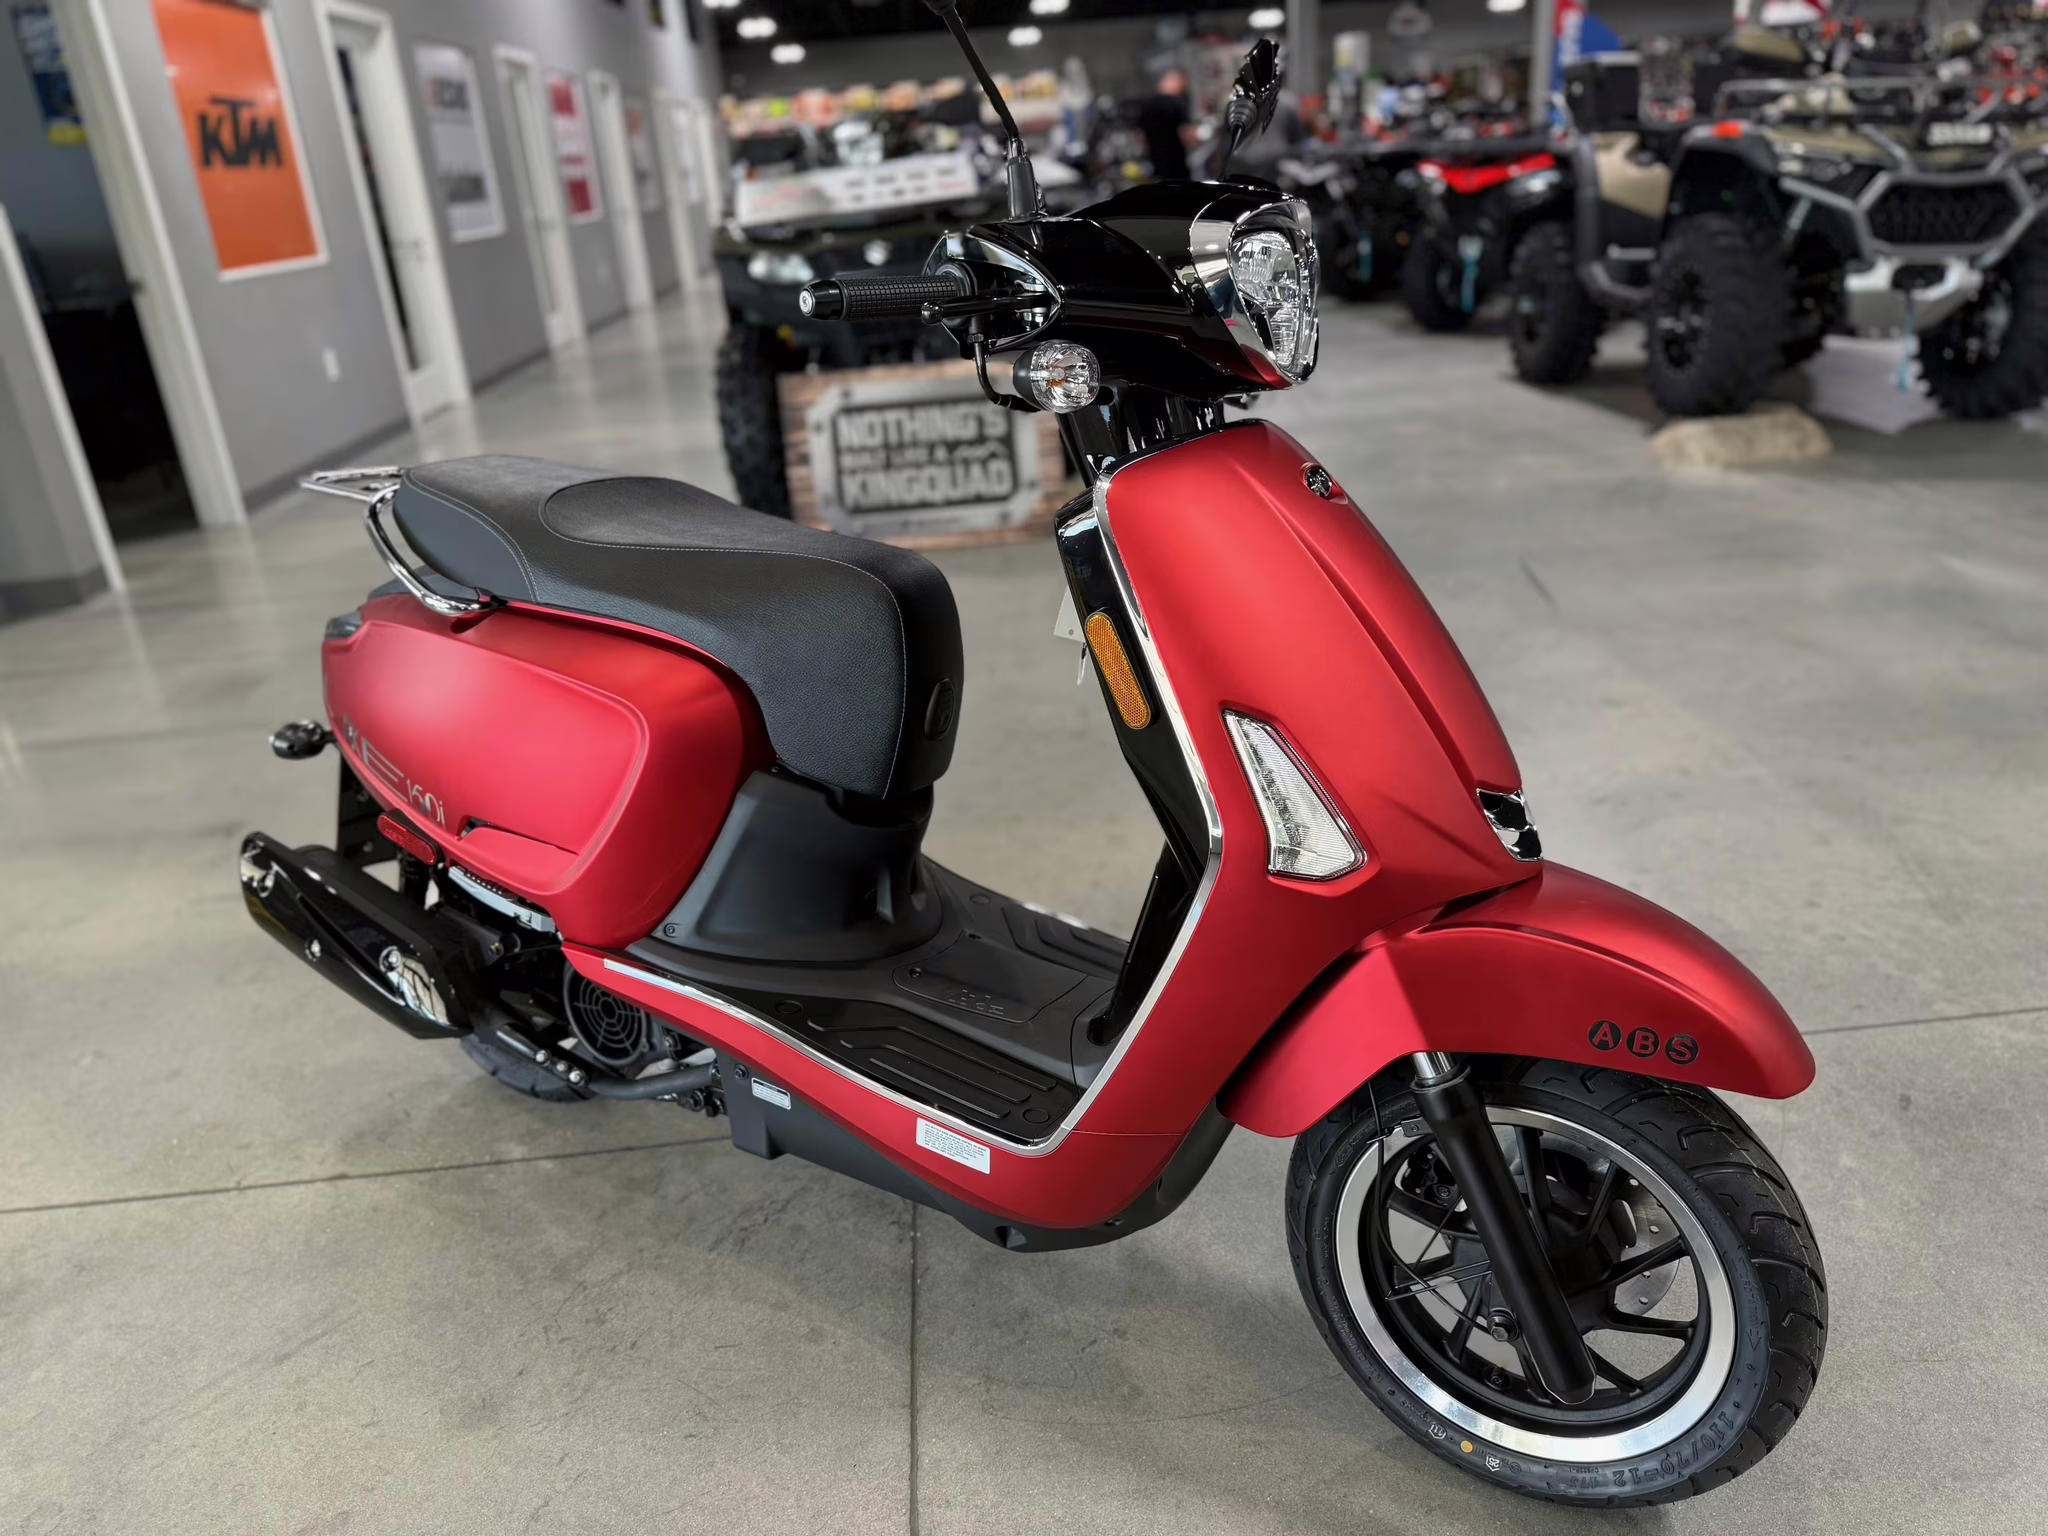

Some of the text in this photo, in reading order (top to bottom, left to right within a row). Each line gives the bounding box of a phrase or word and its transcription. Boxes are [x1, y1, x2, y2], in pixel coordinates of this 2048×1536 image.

[198, 95, 284, 170] KTM
[837, 402, 1008, 449] NOTHING'S
[842, 458, 1013, 509] KINGQUAD
[1591, 1021, 1694, 1062] ABS
